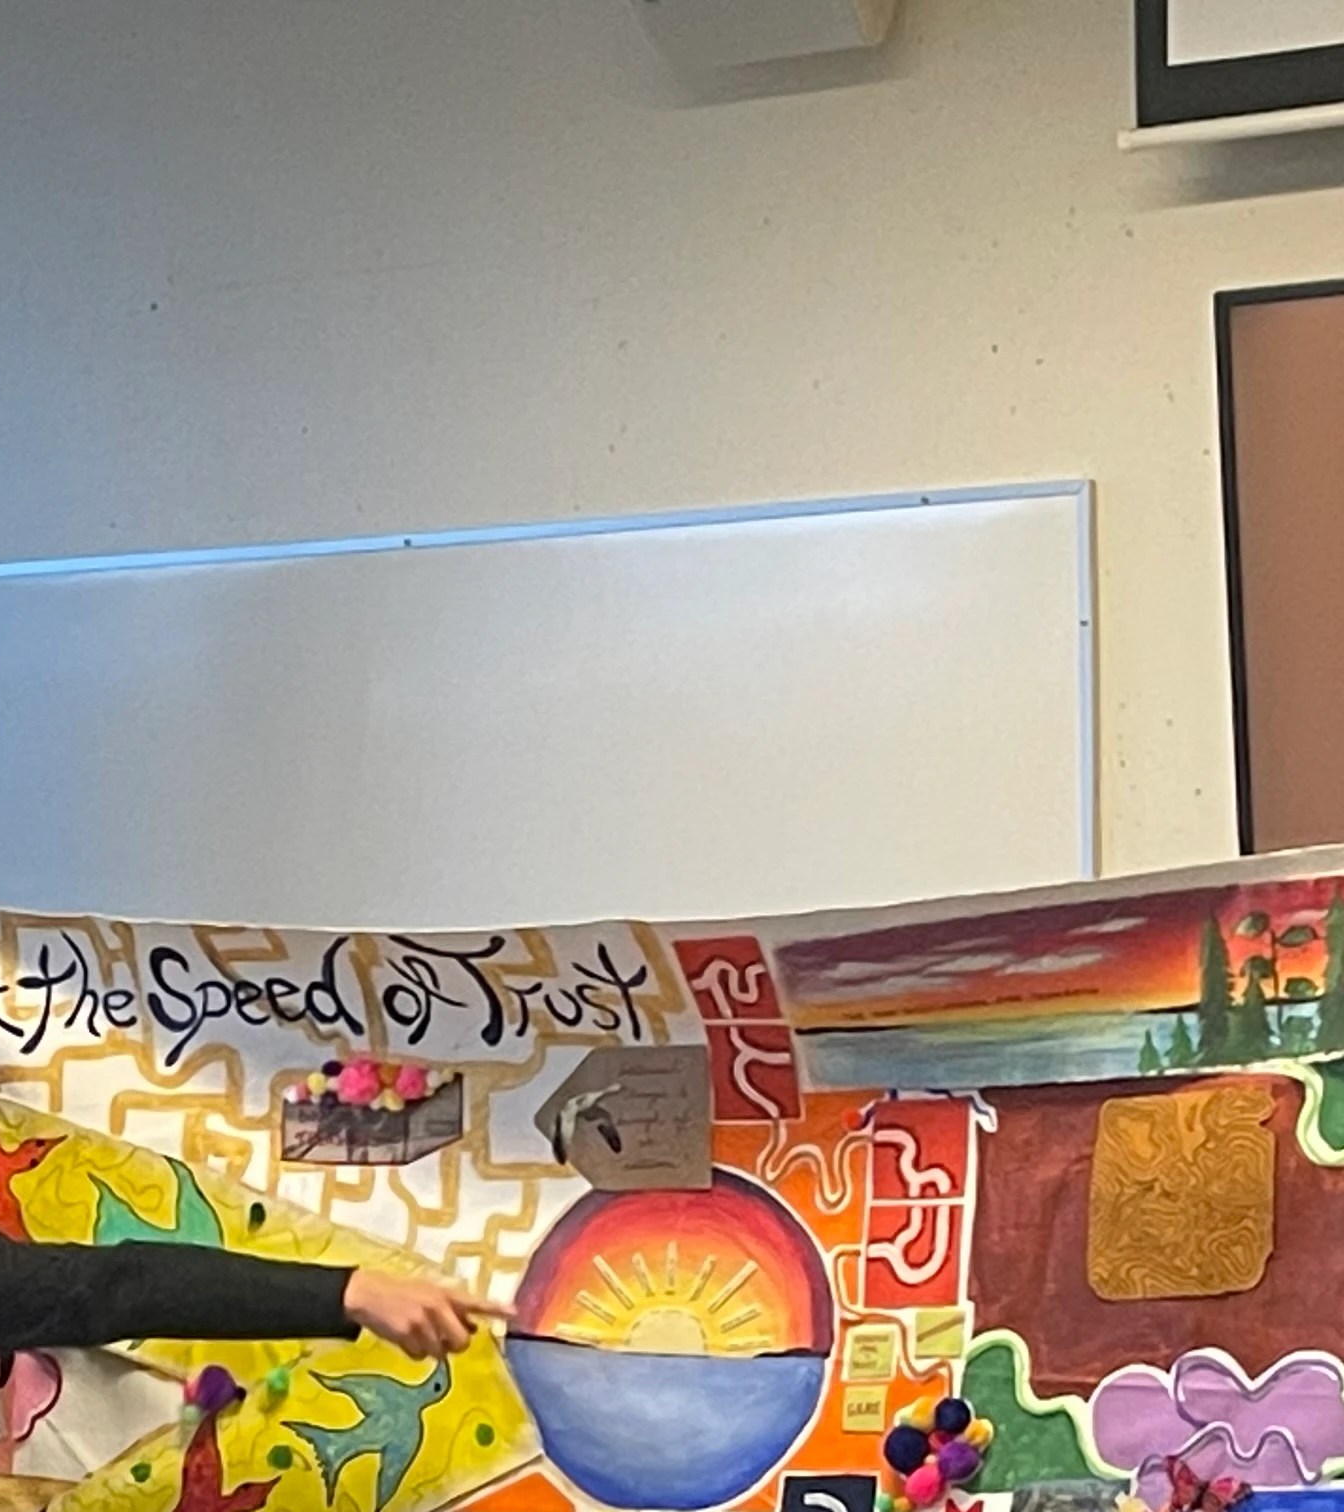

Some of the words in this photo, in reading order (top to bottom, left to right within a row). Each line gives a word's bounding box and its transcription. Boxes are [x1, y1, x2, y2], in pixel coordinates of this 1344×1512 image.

[16, 930, 137, 1055] the
[146, 936, 364, 1067] Speed
[381, 954, 469, 1045] of
[388, 934, 647, 1046] Trust
